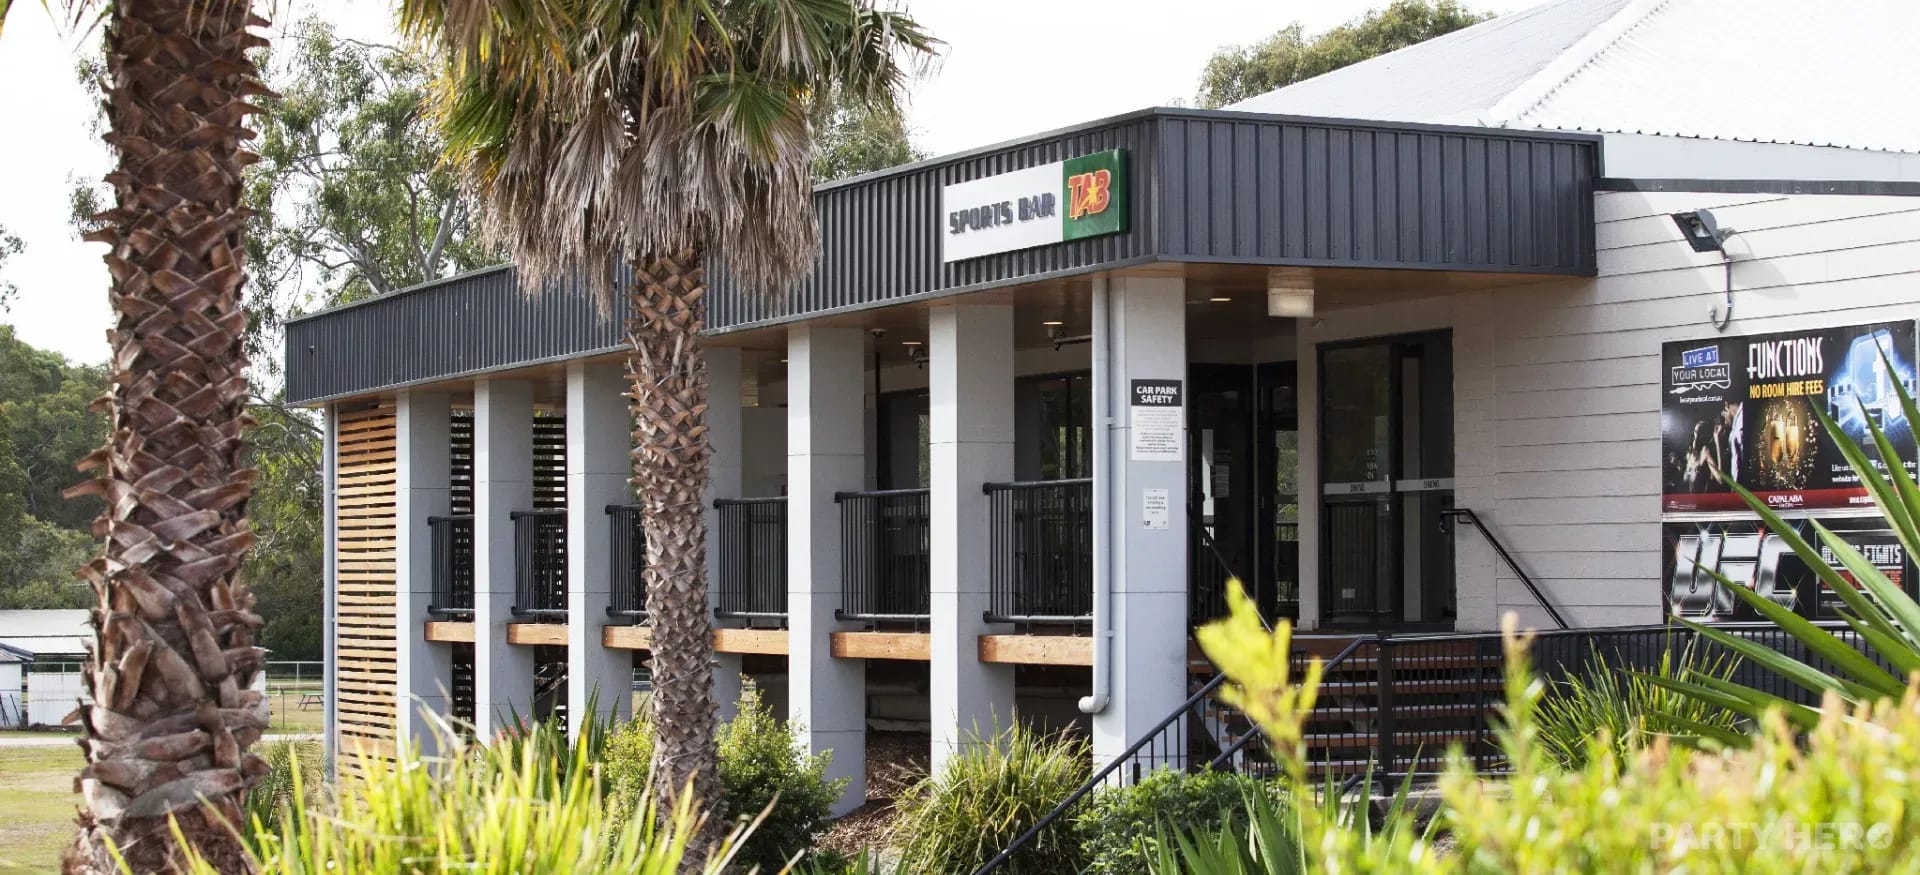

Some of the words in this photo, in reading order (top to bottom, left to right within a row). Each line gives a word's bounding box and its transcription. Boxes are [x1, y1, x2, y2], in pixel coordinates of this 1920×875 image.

[1068, 169, 1111, 219] TAB
[949, 200, 1013, 234] SPORTS
[1018, 192, 1055, 221] BAR
[1684, 352, 1703, 365] LIVE
[1705, 350, 1717, 361] AT
[1746, 336, 1823, 379] FUNCTIONS
[1673, 369, 1697, 381] YOUR
[1699, 367, 1727, 379] LOCAL
[1136, 386, 1154, 395] CAR
[1155, 386, 1177, 396] PARK
[1749, 384, 1761, 399] NO
[1762, 382, 1785, 398] ROOM
[1786, 380, 1804, 396] HIRE
[1805, 379, 1824, 395] FEES
[1141, 395, 1173, 404] SAFETY
[1768, 494, 1803, 504] CAPALABA
[1863, 544, 1902, 564] FIGHTS
